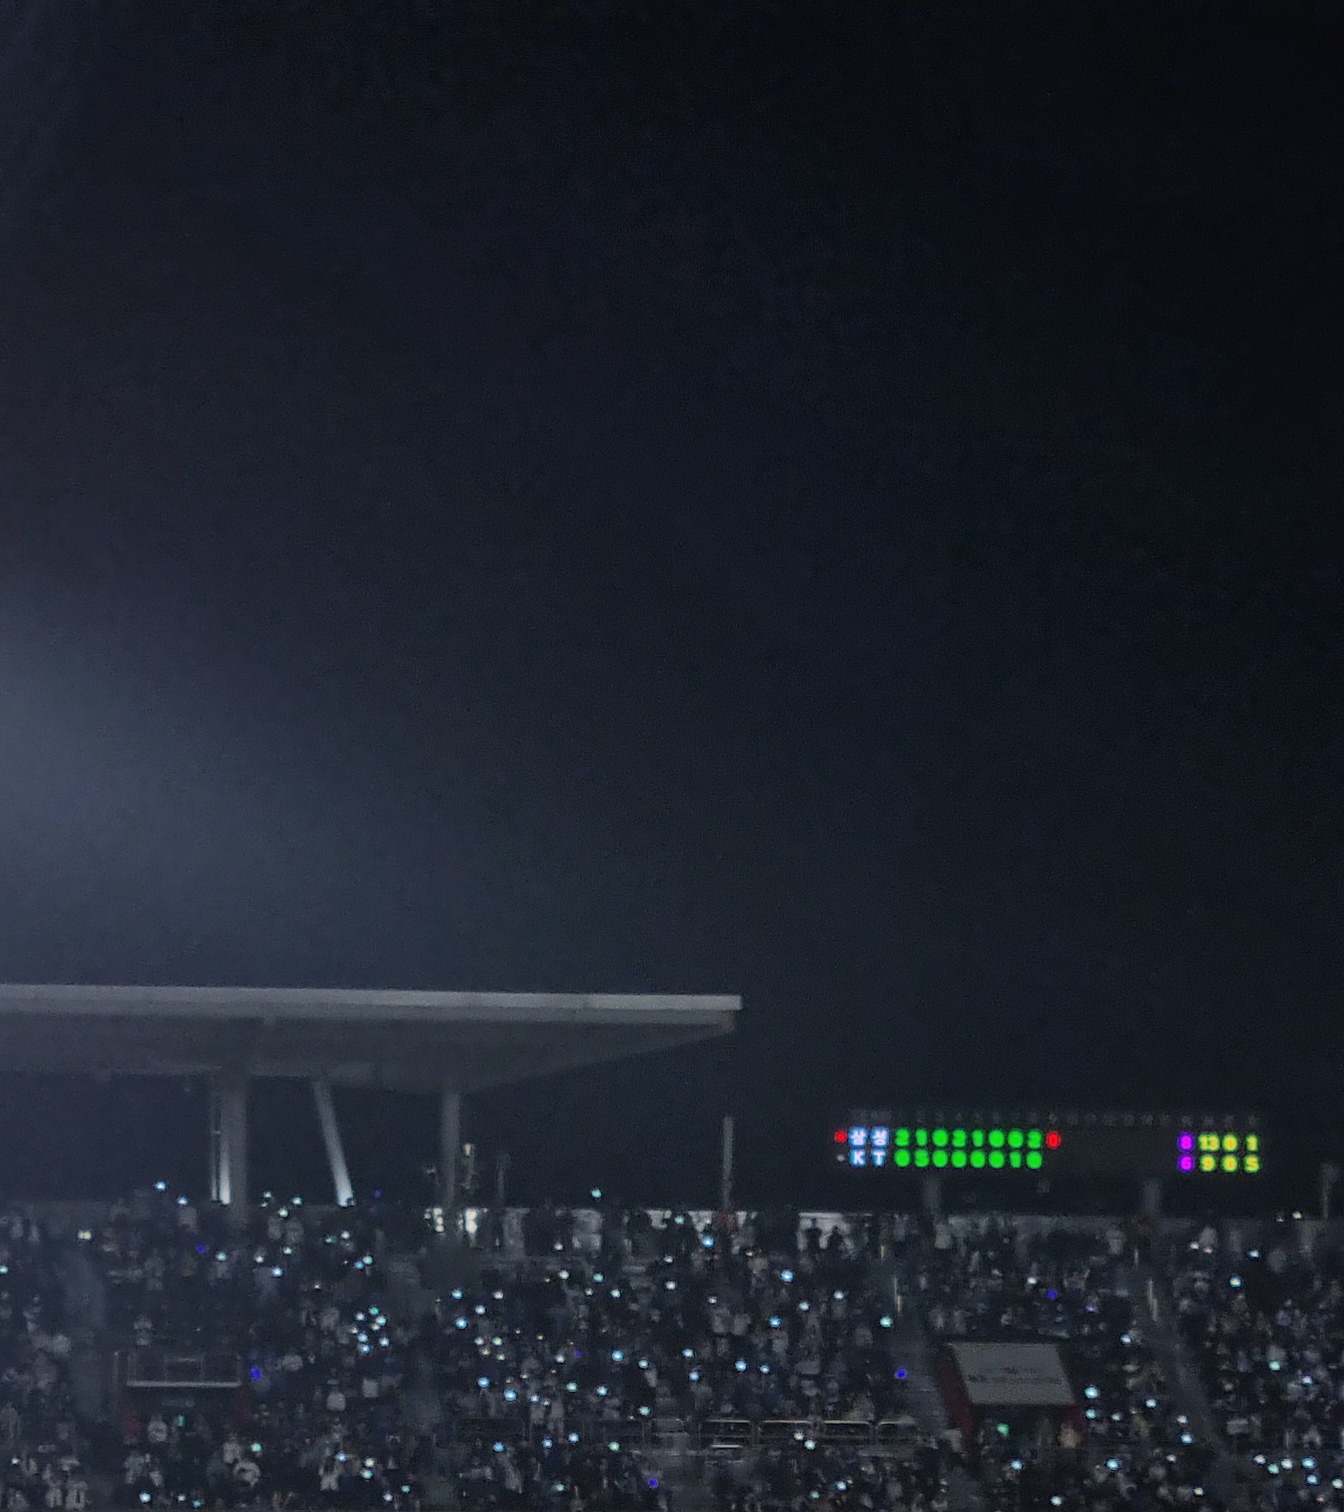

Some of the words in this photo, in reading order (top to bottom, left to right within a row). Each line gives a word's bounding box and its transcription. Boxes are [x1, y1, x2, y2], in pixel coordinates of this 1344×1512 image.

[1177, 1132, 1195, 1151] 8
[1198, 1132, 1220, 1151] 13
[1245, 1134, 1258, 1151] 1
[1177, 1154, 1195, 1172] 6
[1199, 1154, 1216, 1172] 9
